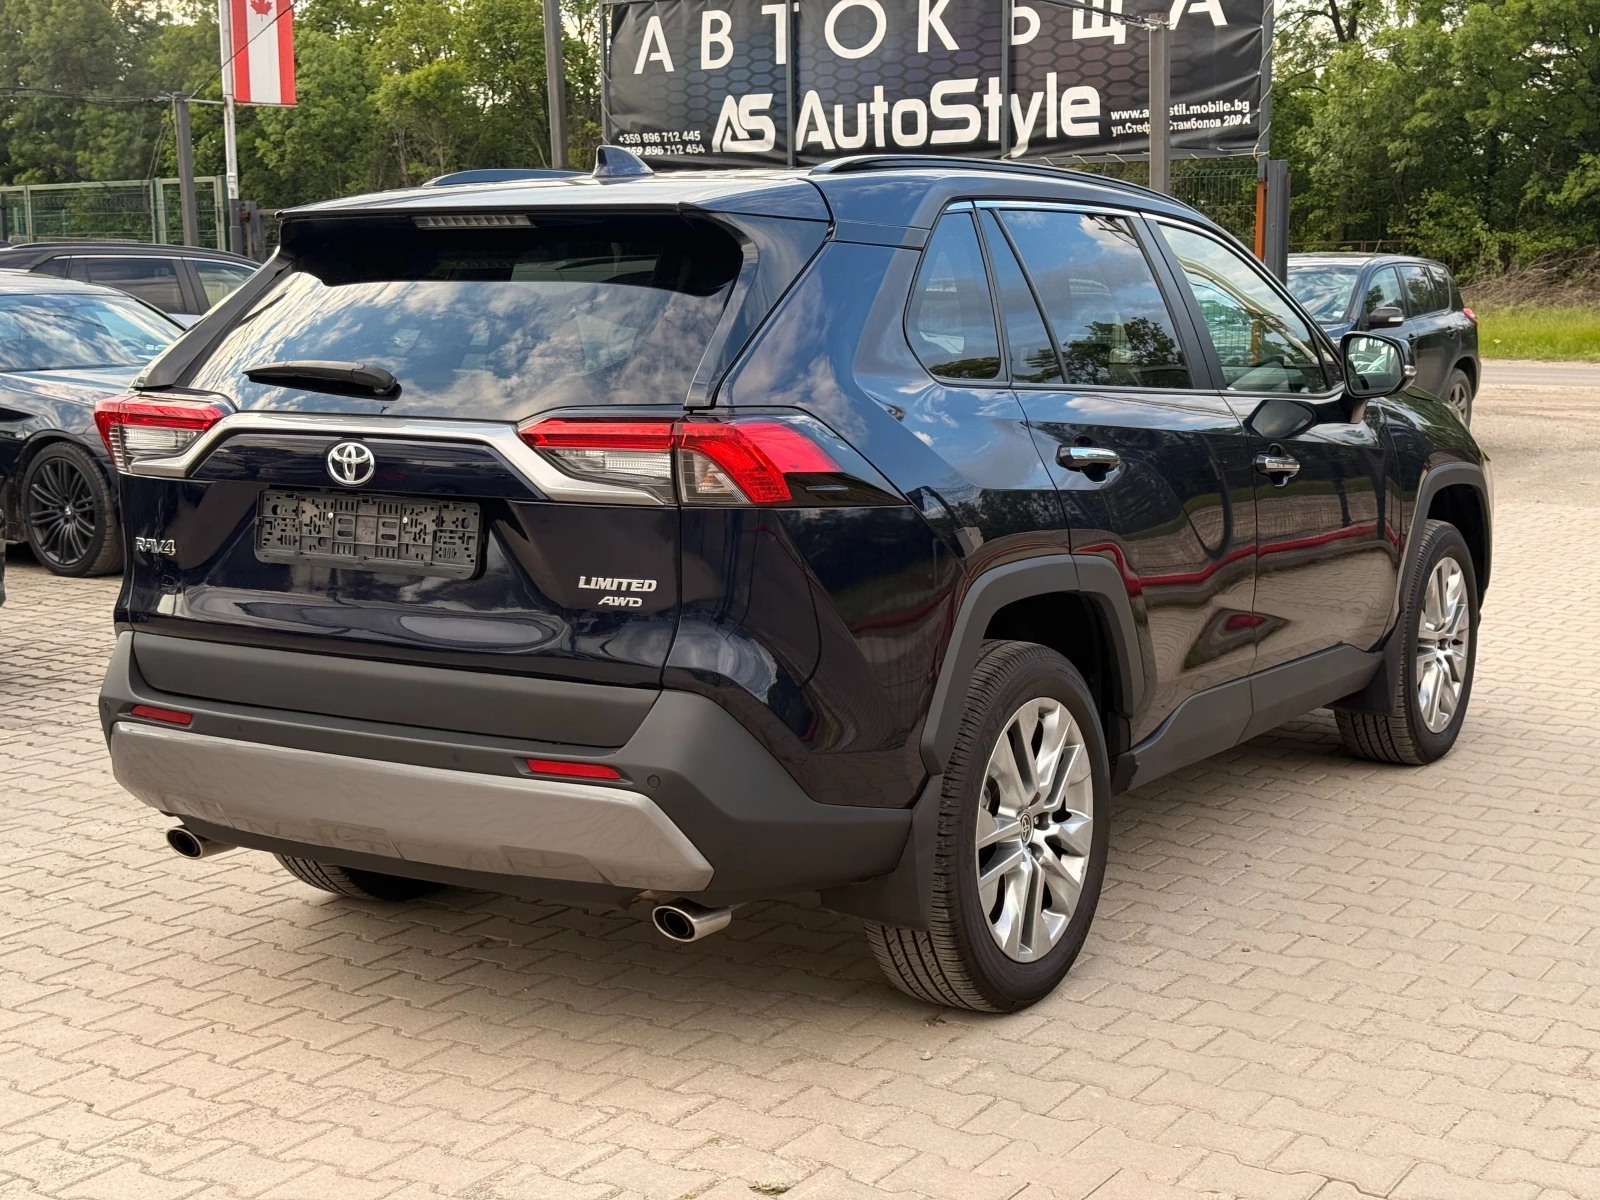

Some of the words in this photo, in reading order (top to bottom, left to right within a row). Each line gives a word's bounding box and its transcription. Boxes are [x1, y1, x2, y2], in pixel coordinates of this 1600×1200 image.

[796, 72, 1101, 158] AutoStyle
[1110, 98, 1250, 121] www.astil.mobile.bg
[712, 93, 776, 153] AS
[618, 133, 641, 144] +359
[642, 132, 661, 143] 896
[662, 131, 681, 143] 712
[682, 130, 701, 142] 445
[644, 145, 664, 156] 896
[665, 144, 684, 155] 712
[685, 143, 705, 154] 454
[135, 536, 176, 556] RAV4
[578, 575, 657, 592] LIMITED
[598, 595, 643, 607] AWD
